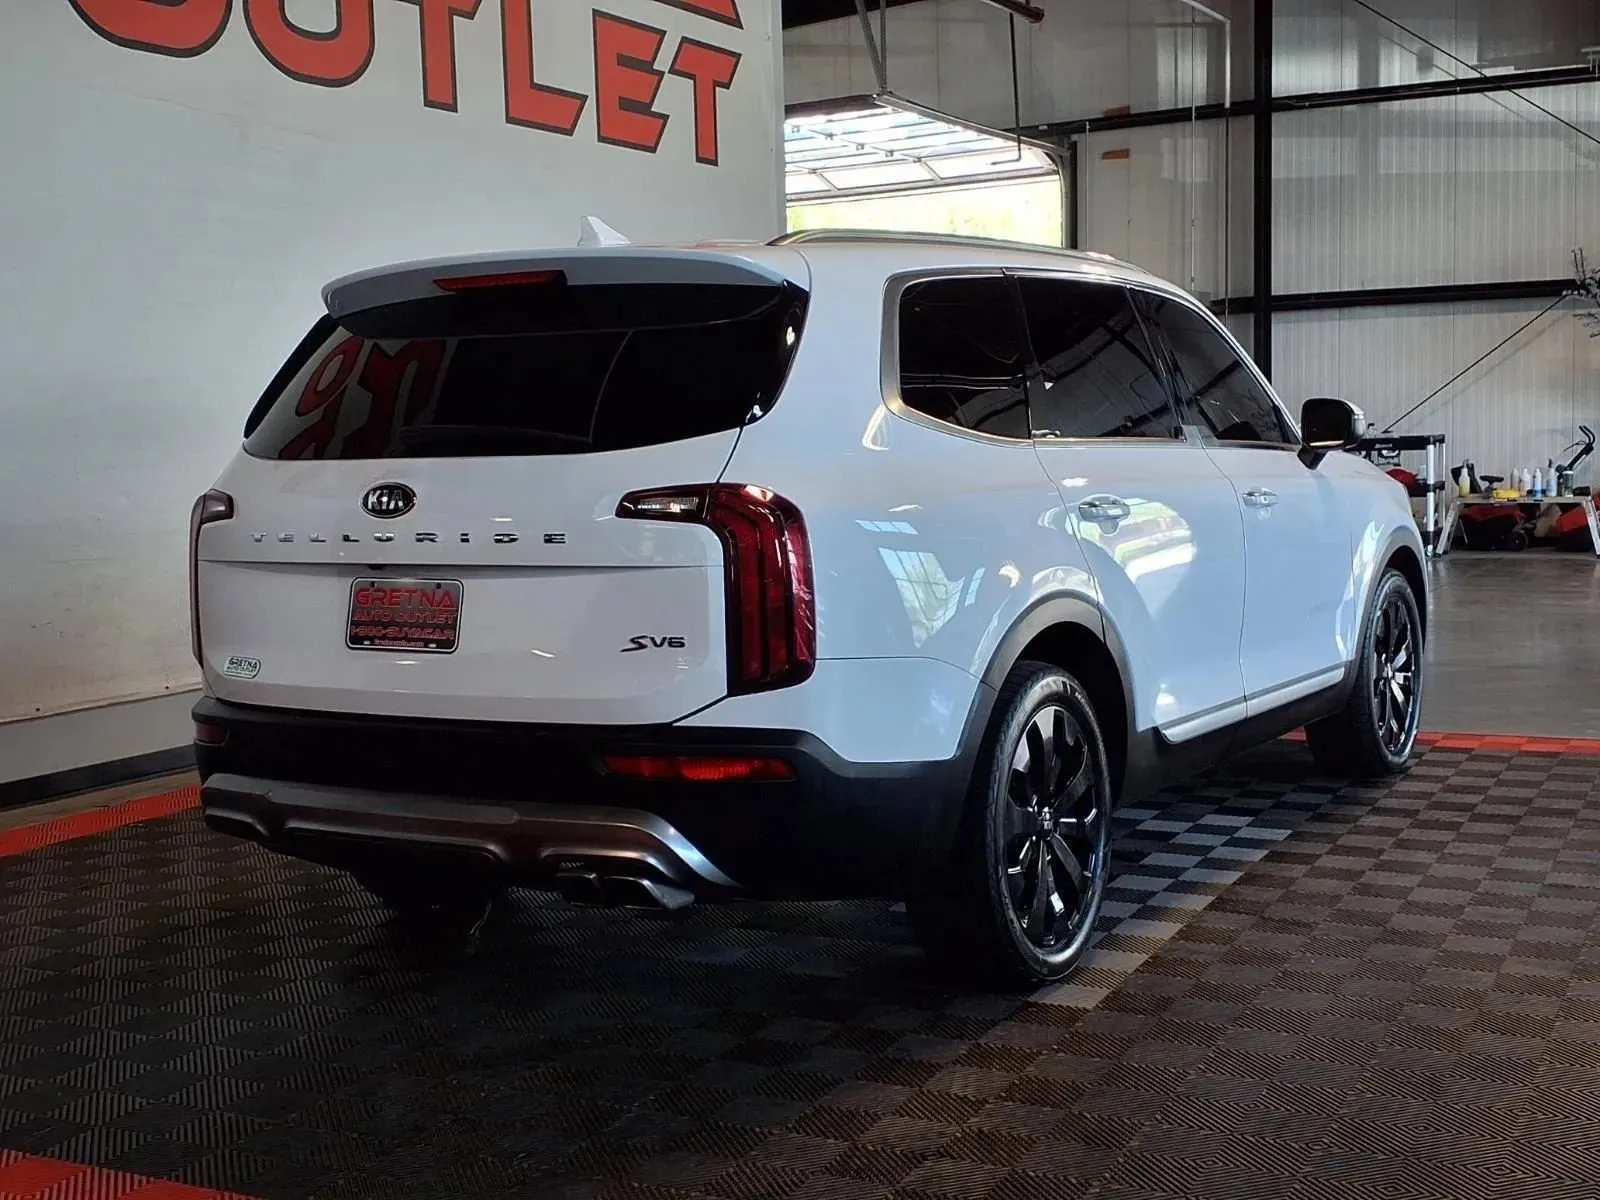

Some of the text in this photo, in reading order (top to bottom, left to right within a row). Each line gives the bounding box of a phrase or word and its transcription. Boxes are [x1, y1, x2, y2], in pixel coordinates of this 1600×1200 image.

[367, 489, 405, 510] KIA
[250, 531, 567, 545] TELLURIDE
[355, 587, 458, 609] GRETNA
[352, 609, 457, 624] AUTO OUTLET
[619, 634, 686, 653] SV6
